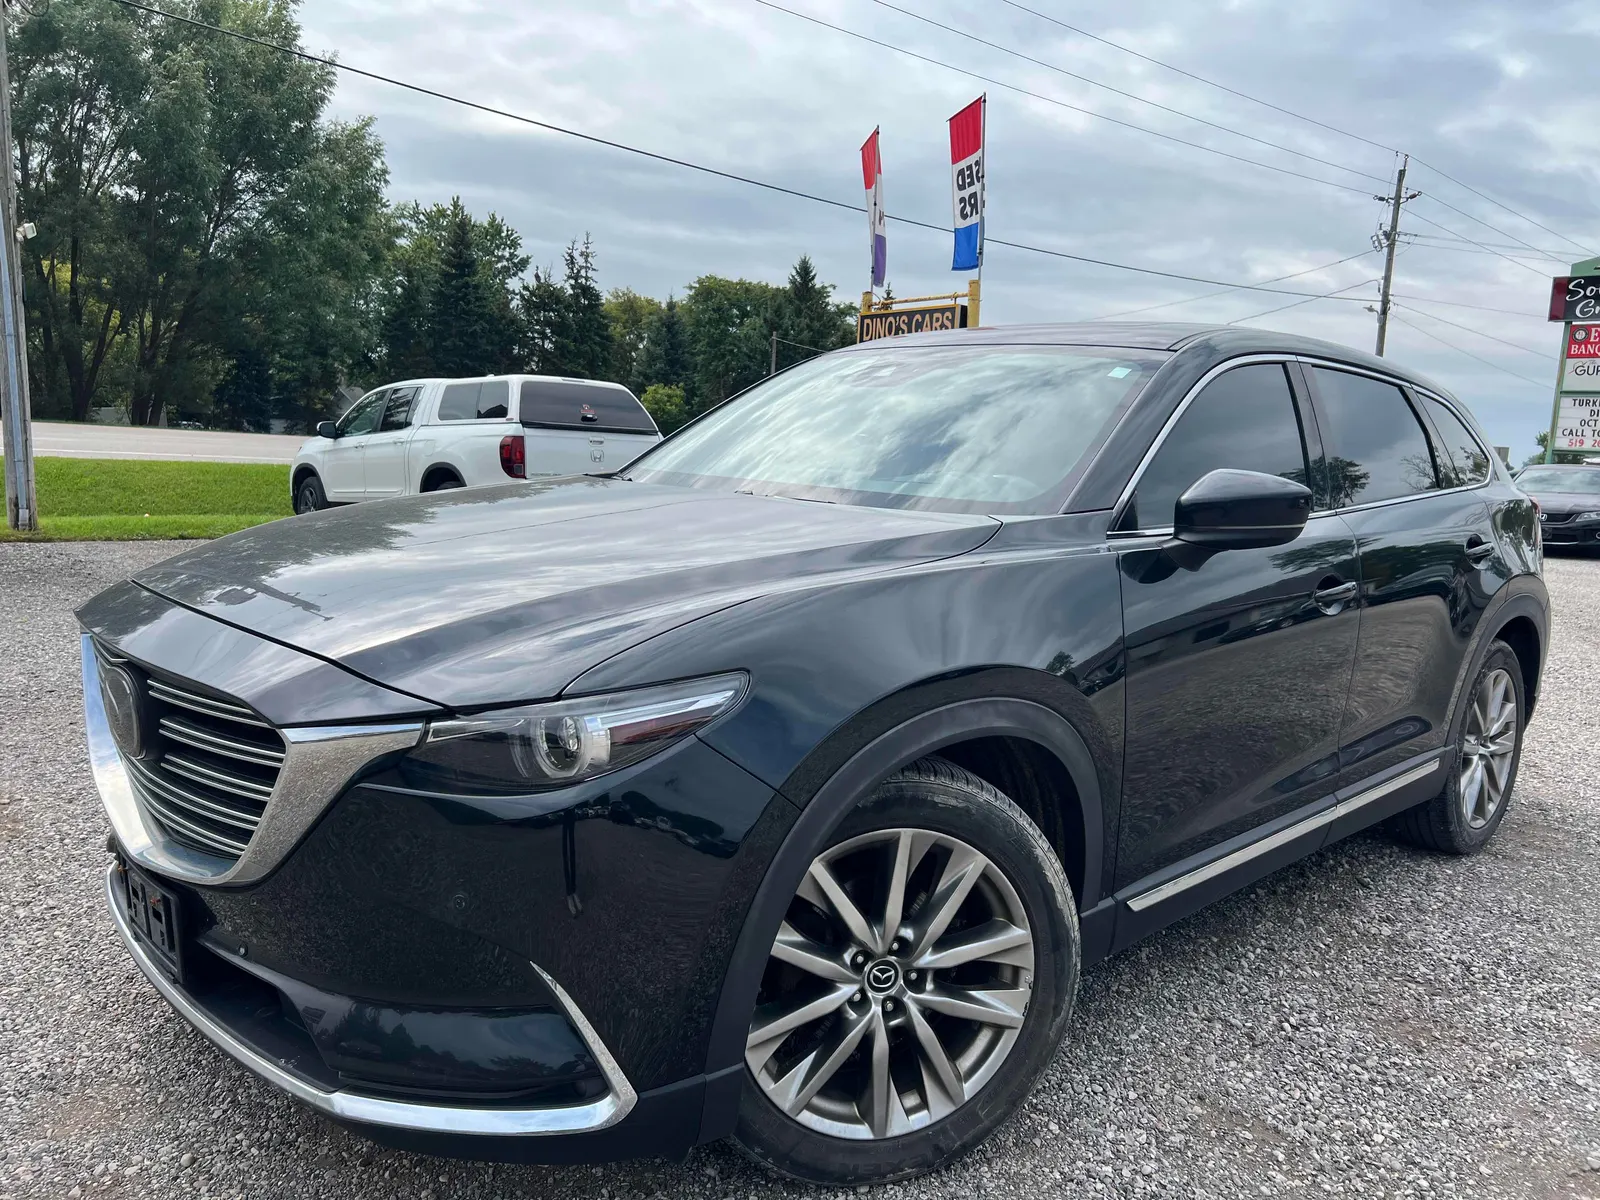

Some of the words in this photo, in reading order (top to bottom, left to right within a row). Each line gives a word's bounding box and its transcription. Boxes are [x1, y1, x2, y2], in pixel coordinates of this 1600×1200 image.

[863, 315, 908, 341] DINO'S
[912, 312, 952, 334] CARS
[1579, 418, 1599, 428] OCT
[1562, 428, 1586, 437] CALL
[1568, 438, 1584, 447] 519
